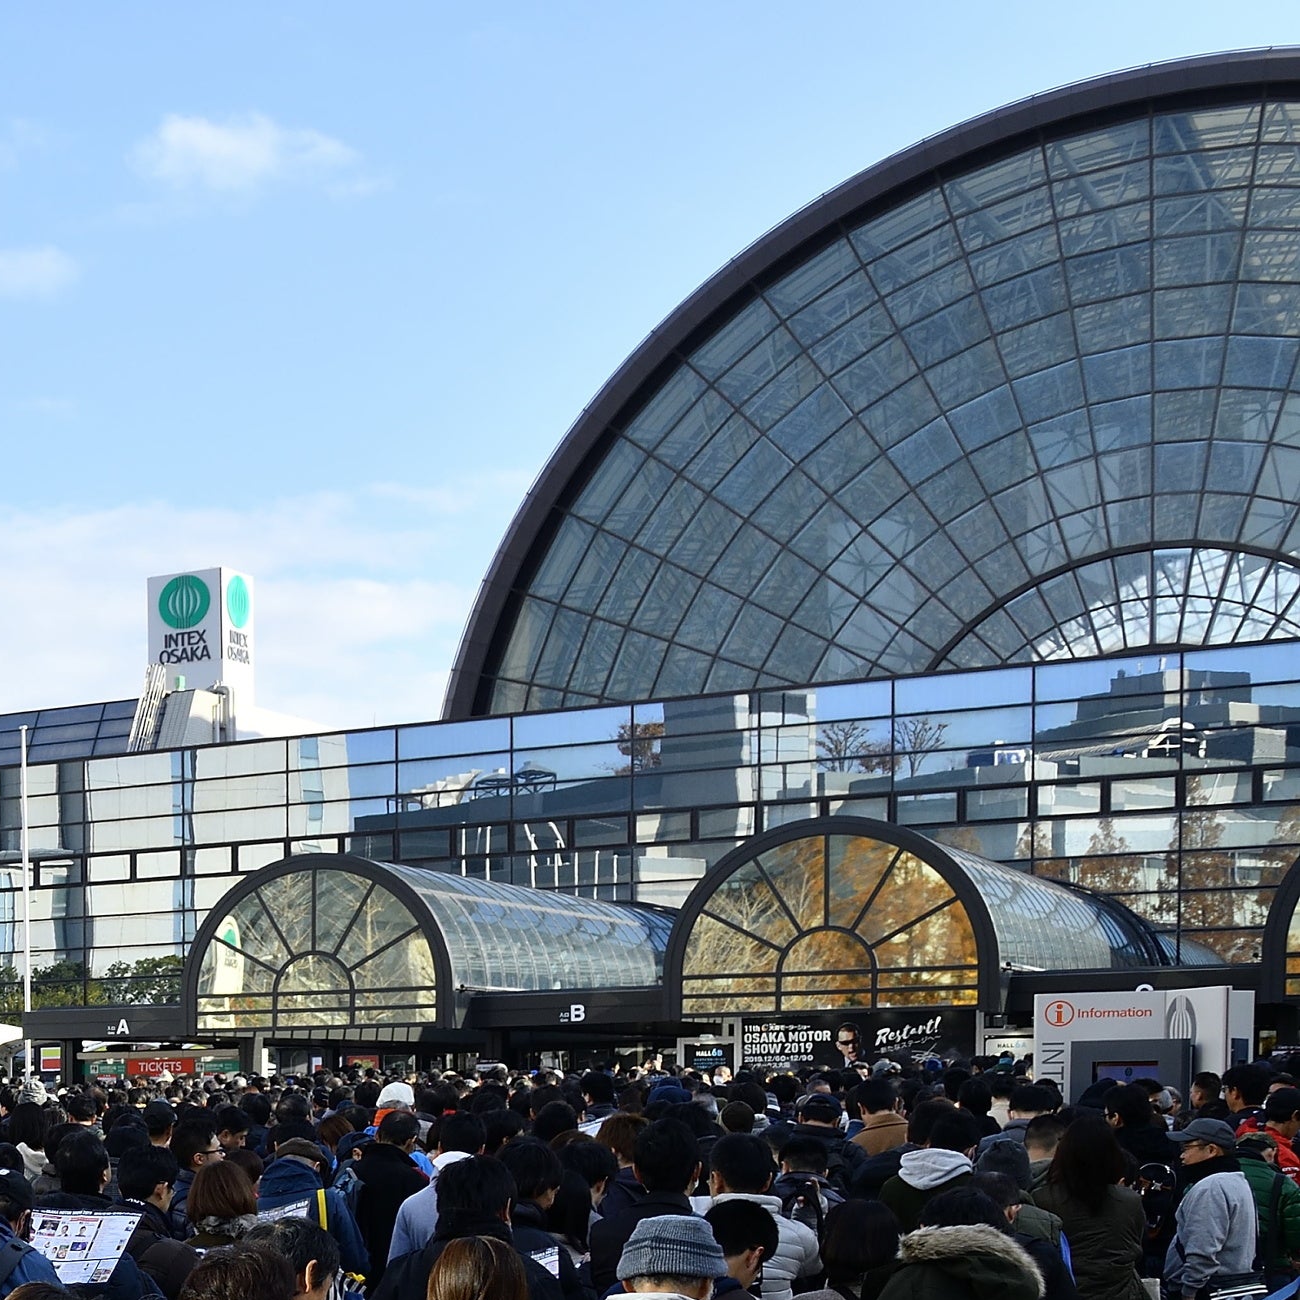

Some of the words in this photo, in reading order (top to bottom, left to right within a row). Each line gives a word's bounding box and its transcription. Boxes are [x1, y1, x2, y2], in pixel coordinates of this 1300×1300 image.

[164, 629, 207, 649] INTEX
[229, 630, 249, 648] INTEX
[159, 644, 211, 665] OSAKA
[227, 646, 250, 664] OSAKA
[570, 1004, 585, 1022] B
[1077, 1007, 1152, 1020] Information
[116, 1018, 130, 1035] A
[875, 1016, 942, 1046] Restart!
[744, 1032, 786, 1044] OSAKA
[788, 1030, 831, 1042] MOTOR
[744, 1043, 781, 1054] SHOW
[784, 1042, 813, 1054] 2019
[138, 1061, 182, 1072] TICKETS
